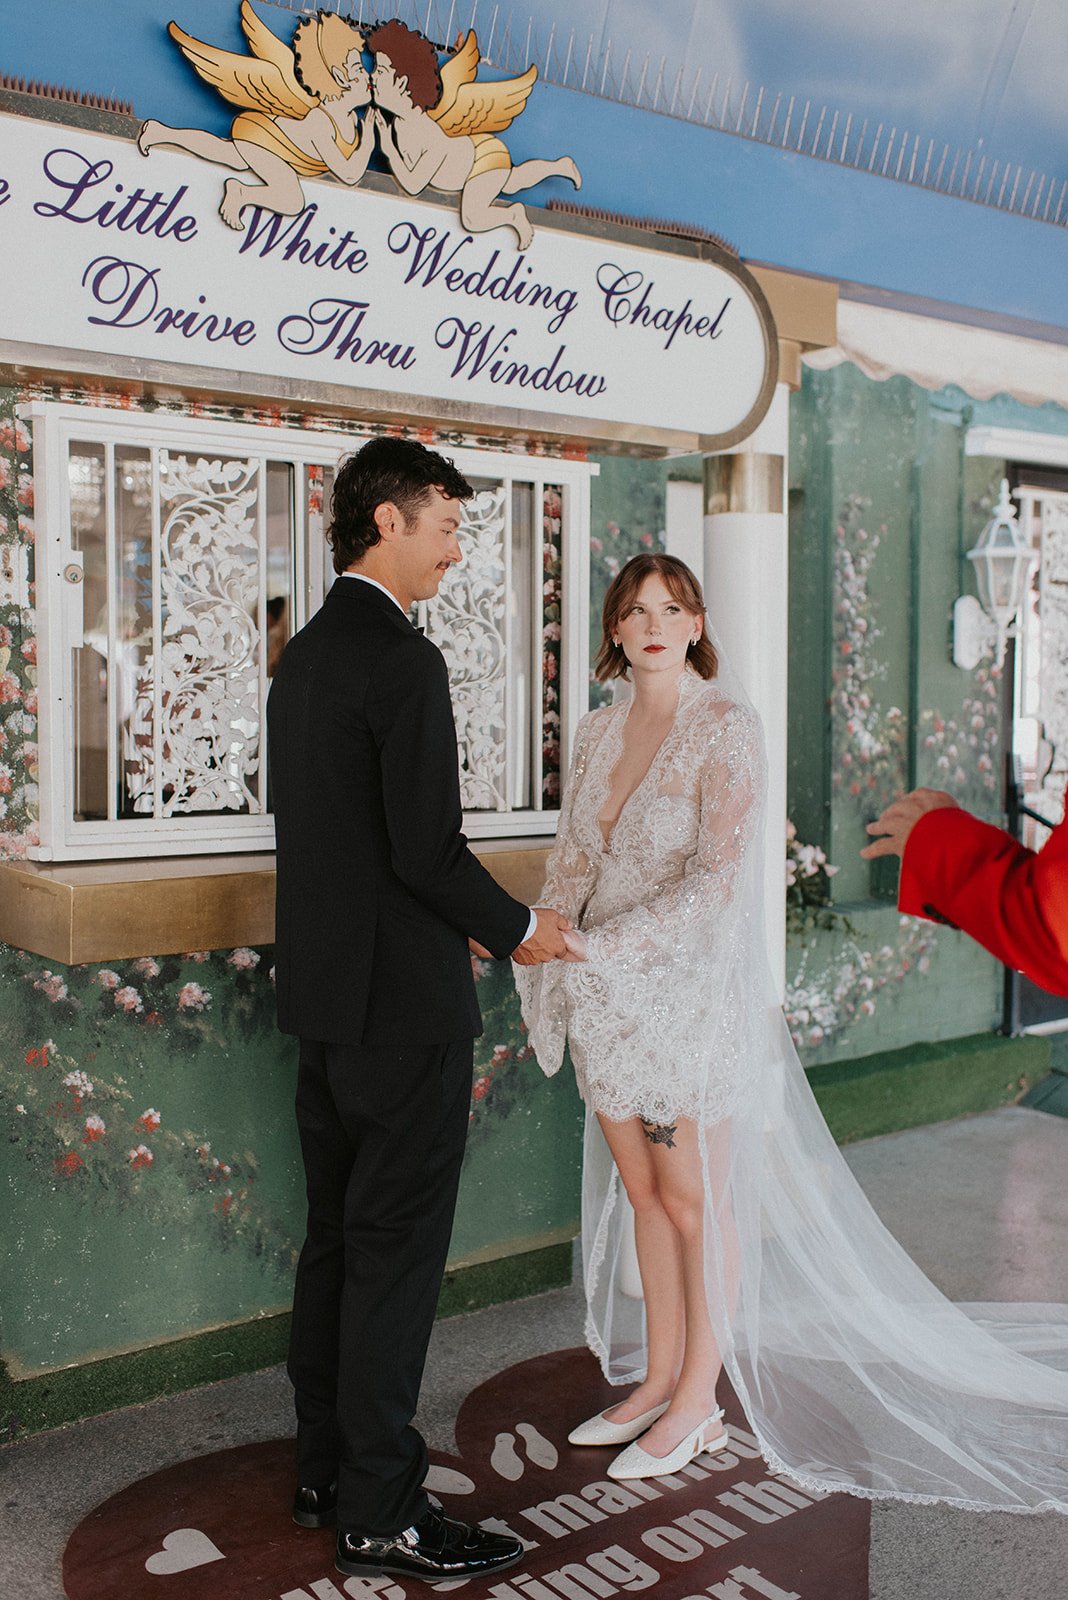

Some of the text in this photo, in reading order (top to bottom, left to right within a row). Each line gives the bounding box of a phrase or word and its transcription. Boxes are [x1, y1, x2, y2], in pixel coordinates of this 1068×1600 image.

[34, 148, 732, 350] Little White Wedding Chapel
[81, 255, 607, 398] Drive Thru Window
[640, 1508, 748, 1563] on
